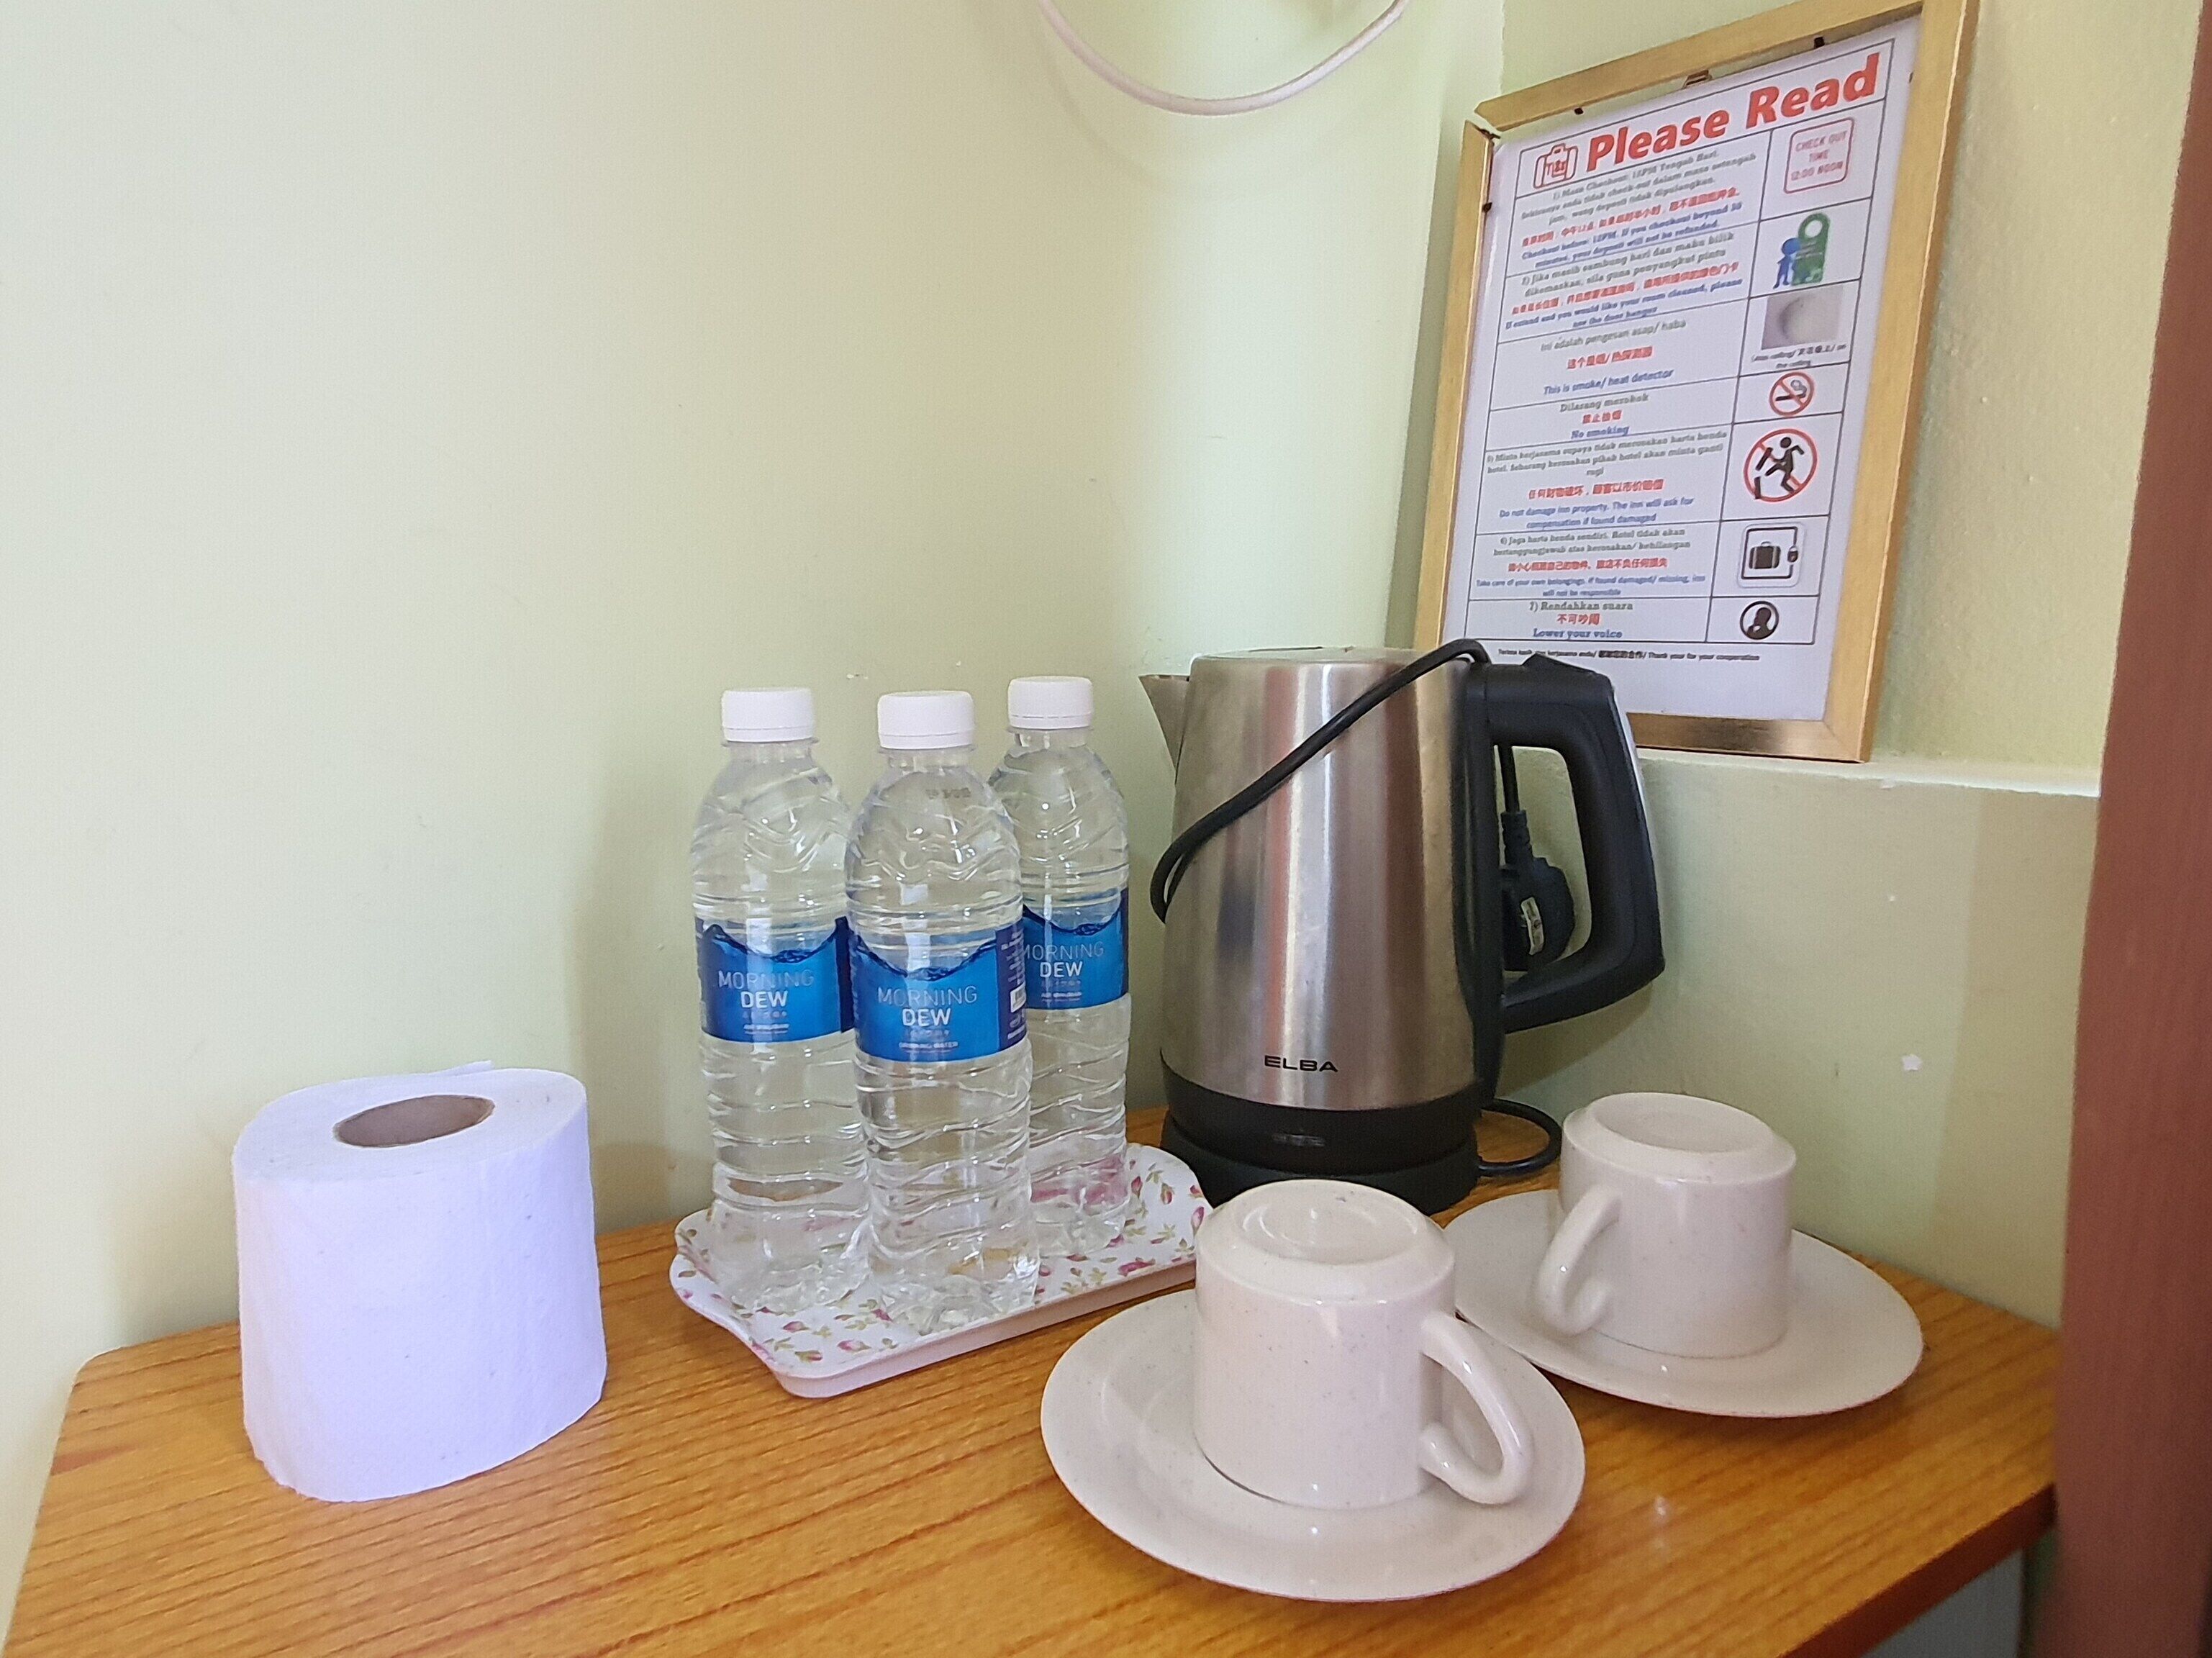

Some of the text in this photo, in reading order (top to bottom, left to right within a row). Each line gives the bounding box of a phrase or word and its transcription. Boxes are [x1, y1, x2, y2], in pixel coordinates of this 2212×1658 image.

[1585, 51, 1880, 173] Please Read
[1794, 130, 1849, 153] CHECK OUT
[1808, 148, 1831, 163] TIME
[1543, 368, 1675, 396] This is smoke/ heat detector
[1559, 392, 1649, 413] Dilarang merokok
[1569, 425, 1631, 440] No smoking
[1539, 600, 1600, 611] Rendahkan
[1601, 602, 1633, 611] suara
[1531, 628, 1623, 639] Lower your voice
[1023, 941, 1104, 961] MORNING
[718, 969, 815, 989] MORNING
[1040, 961, 1083, 978] DEW
[740, 991, 788, 1008] DEW
[878, 986, 977, 1006] MORNING
[902, 1008, 951, 1027] DEW
[1264, 1055, 1338, 1072] ELBA
